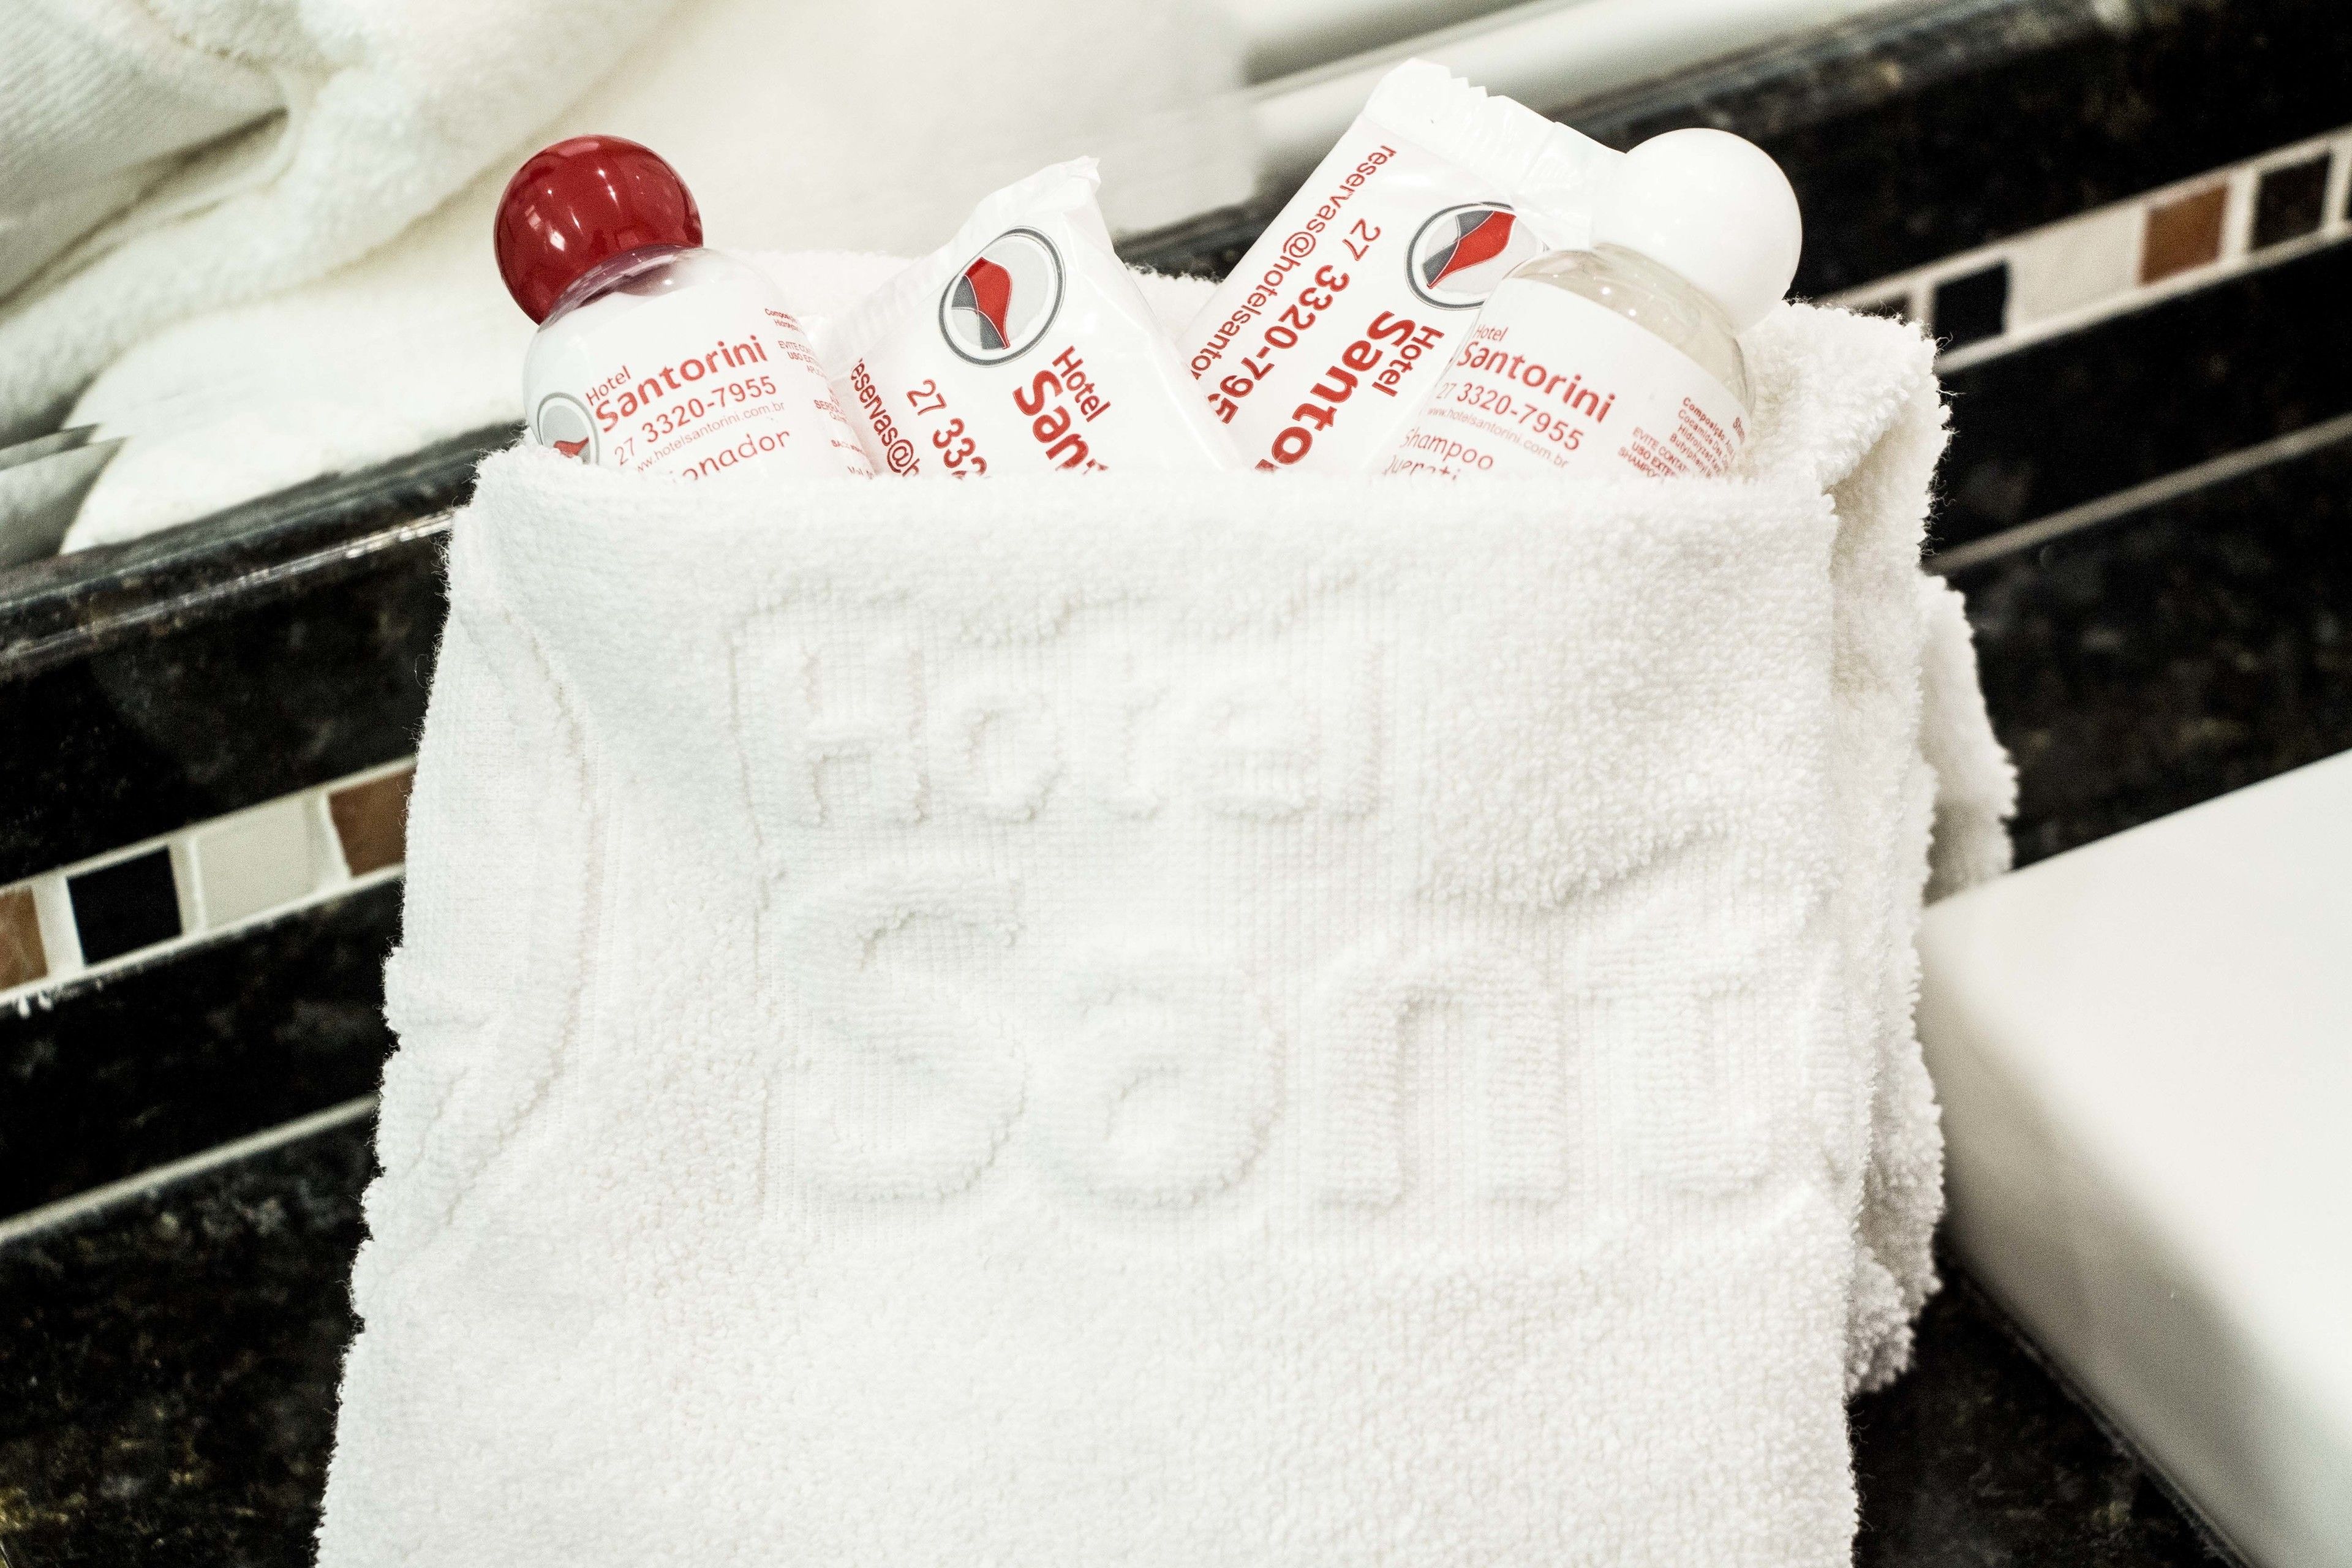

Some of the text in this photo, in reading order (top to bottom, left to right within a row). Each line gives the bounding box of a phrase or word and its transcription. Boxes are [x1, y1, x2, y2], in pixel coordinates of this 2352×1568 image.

[1341, 217, 1382, 262] 27
[1371, 325, 1446, 398] Hotel
[1474, 324, 1509, 342] Hotel
[586, 365, 631, 406] Hotel
[595, 334, 768, 433] Santorini
[906, 379, 948, 417] 27
[1052, 345, 1111, 423] Hotel
[1436, 382, 1585, 451] 27 3320-7955
[1456, 341, 1616, 423] Santorini
[614, 437, 635, 466] 27
[642, 375, 777, 443] 3320-7955
[1399, 427, 1494, 471] Shampoo
